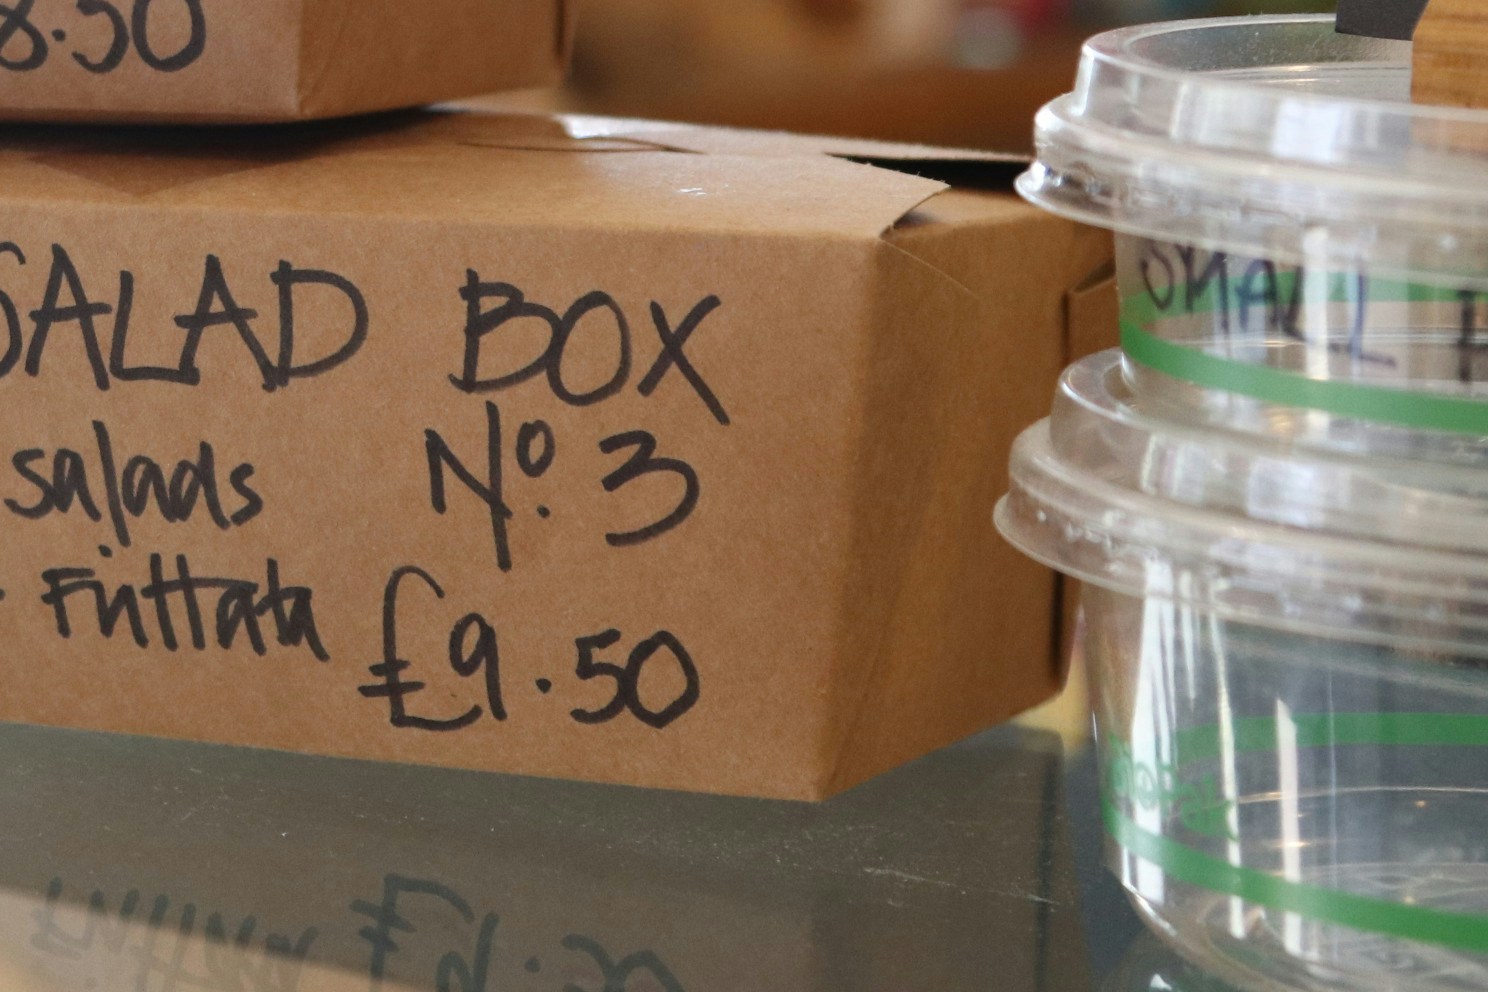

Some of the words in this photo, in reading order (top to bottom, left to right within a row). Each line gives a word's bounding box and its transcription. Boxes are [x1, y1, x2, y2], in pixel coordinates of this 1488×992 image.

[448, 268, 731, 426] BOX
[3, 419, 264, 548] salads
[357, 564, 701, 731] £9.50
